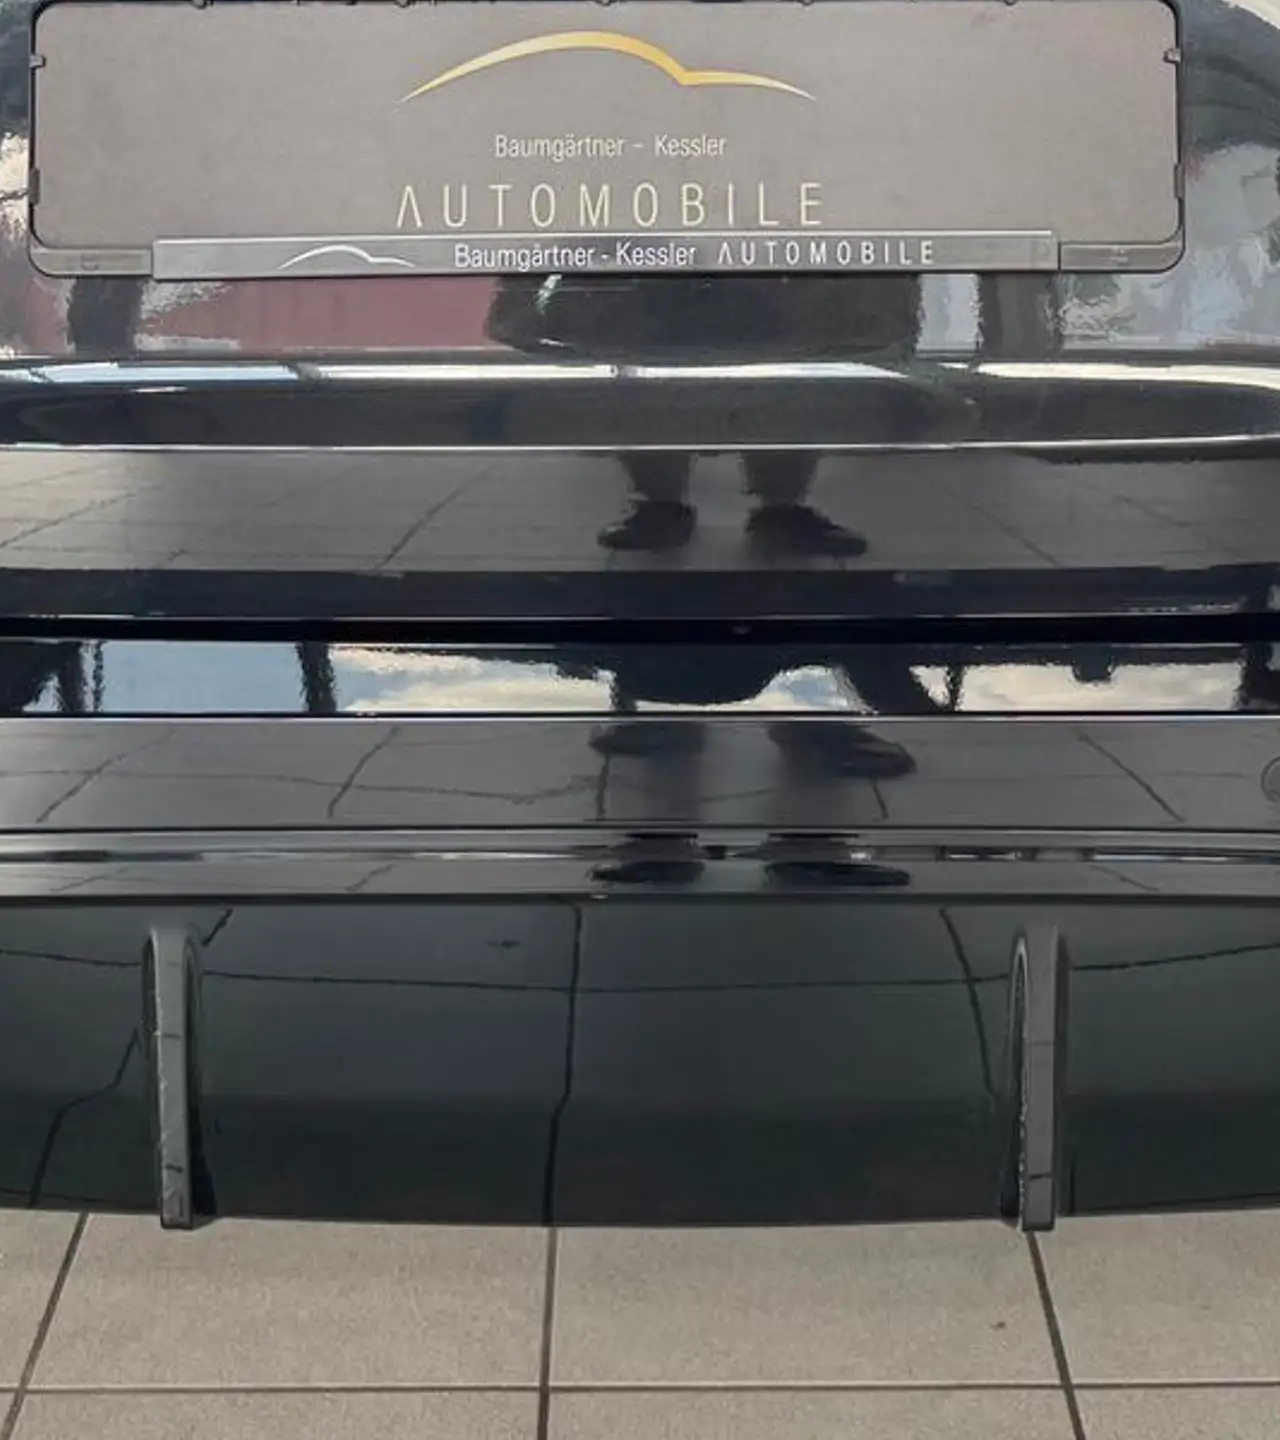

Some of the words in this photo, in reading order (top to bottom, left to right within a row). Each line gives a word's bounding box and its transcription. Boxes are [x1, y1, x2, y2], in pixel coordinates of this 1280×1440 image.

[495, 134, 625, 162] Baumgärtner
[654, 133, 727, 157] Kessler
[396, 182, 822, 229] AUTOMOBILE
[454, 243, 595, 271] Baumgärtner
[615, 241, 697, 266] Kessler
[718, 240, 935, 266] AUTOMOBILE
